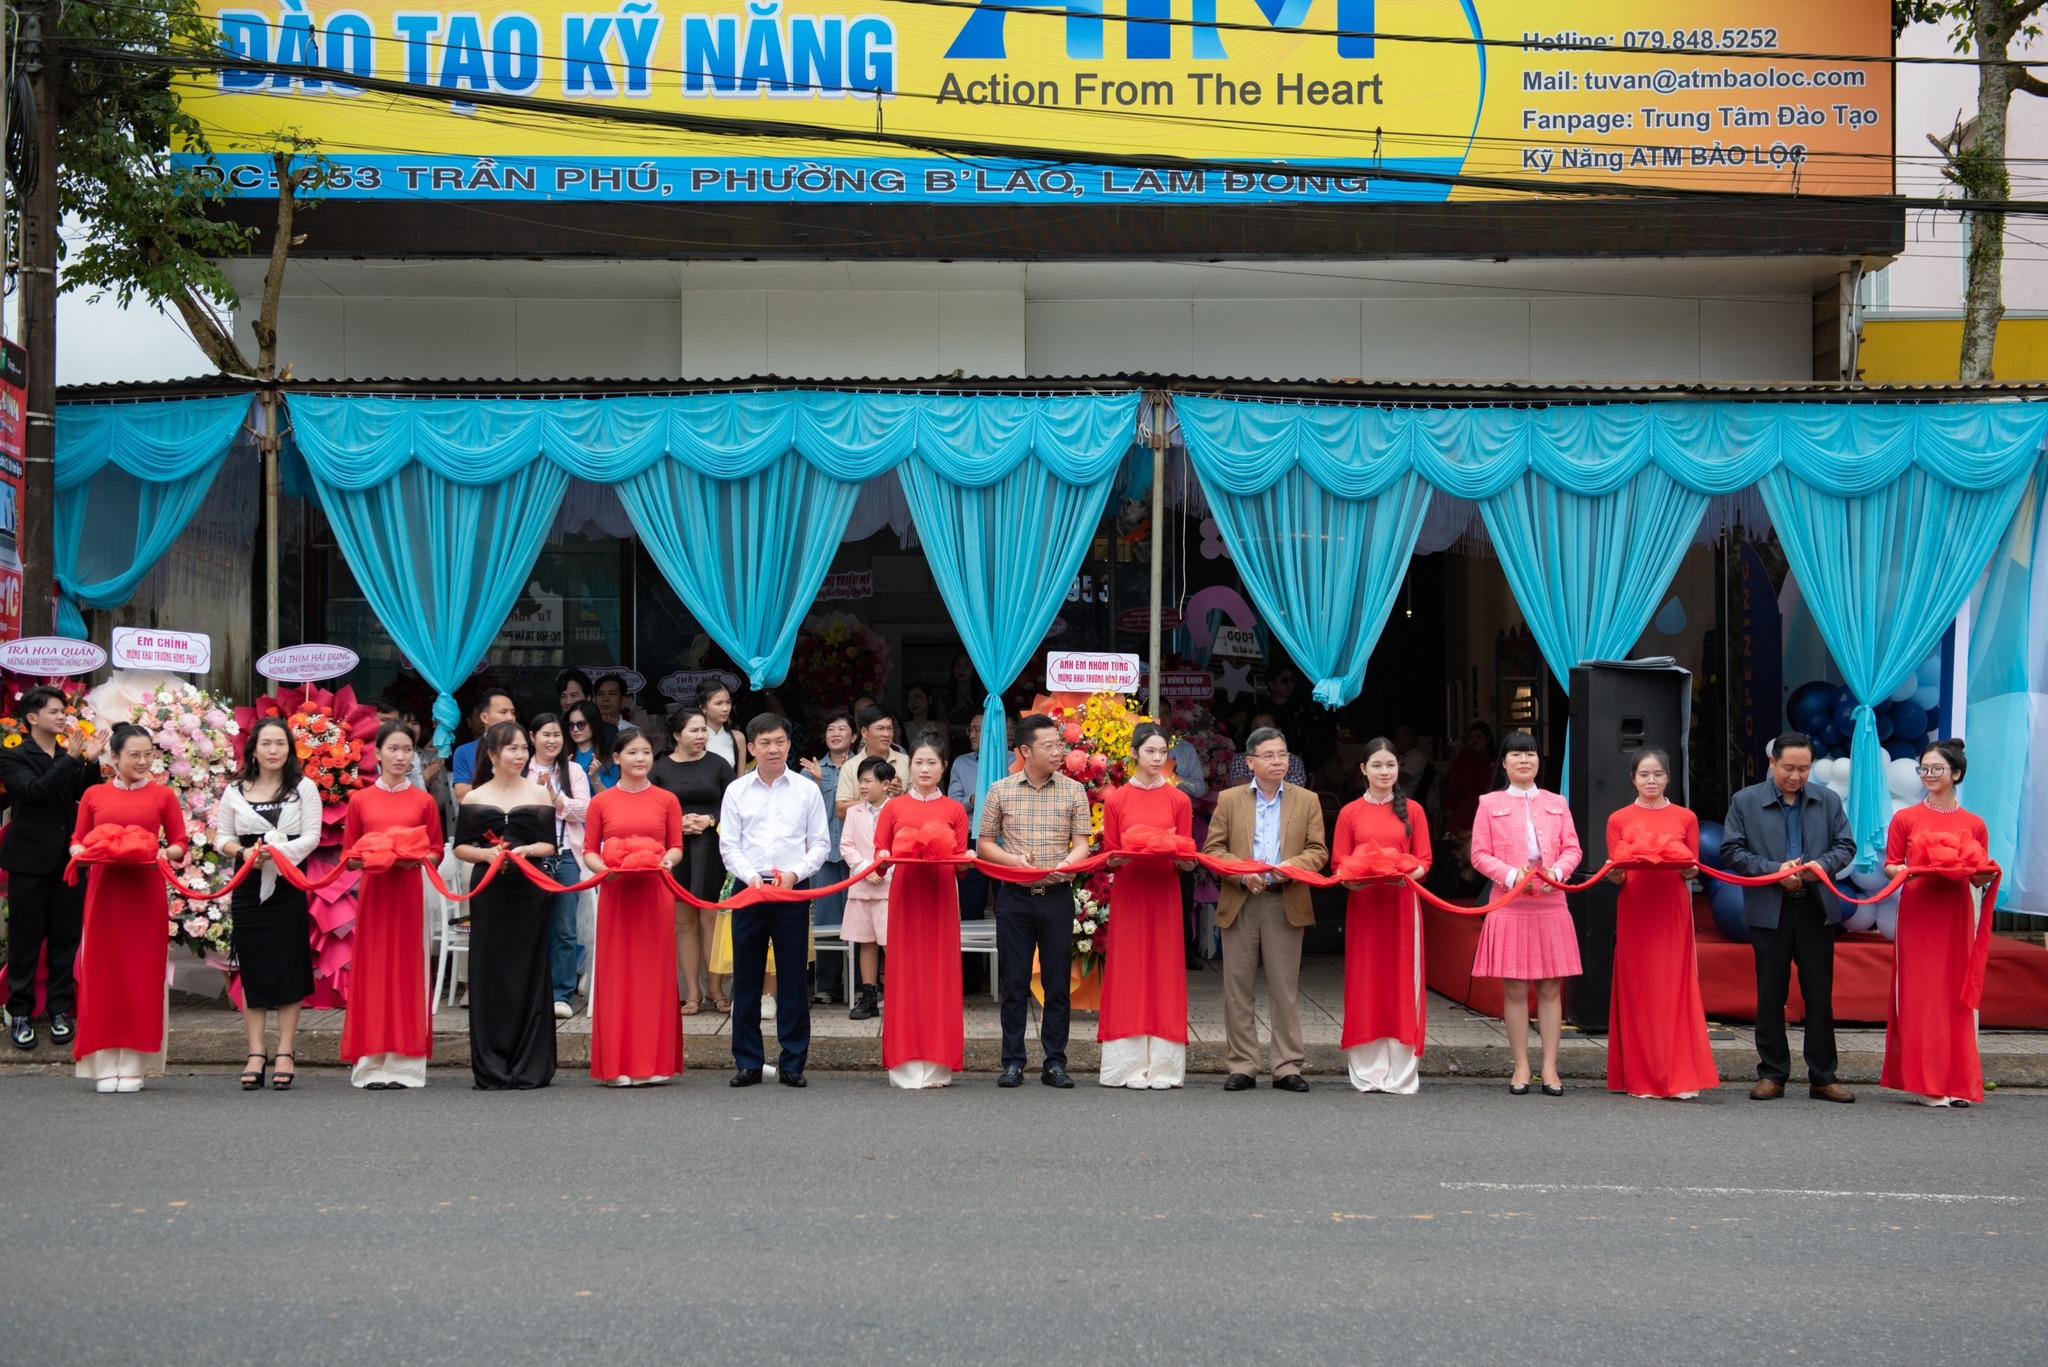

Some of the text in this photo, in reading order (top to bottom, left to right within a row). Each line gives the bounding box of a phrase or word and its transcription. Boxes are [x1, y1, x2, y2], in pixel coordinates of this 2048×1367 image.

[1522, 29, 1778, 52] Hotline: 079.848.5252
[395, 12, 542, 113] TẠO
[563, 1, 663, 96] KỸ
[682, 1, 897, 97] NĂNG
[936, 73, 1383, 105] Action From The Heart
[1522, 66, 1866, 94] Mail: tuvan@atmbaoloc.com
[1522, 103, 1879, 134] Fanpage: Trung Tâm Đào Tạo
[1521, 141, 1808, 173] Kỹ Năng ATM BẢO LỘC
[397, 157, 537, 192] TRẦN
[555, 161, 674, 197] PHÚ,
[690, 161, 906, 193] PHƯỜNG
[8, 644, 96, 657] TRÀ HOA QUÁN
[137, 636, 153, 647] EM
[1059, 660, 1074, 670] ANH
[1075, 661, 1087, 670] EM
[1088, 659, 1109, 671] NHÓM
